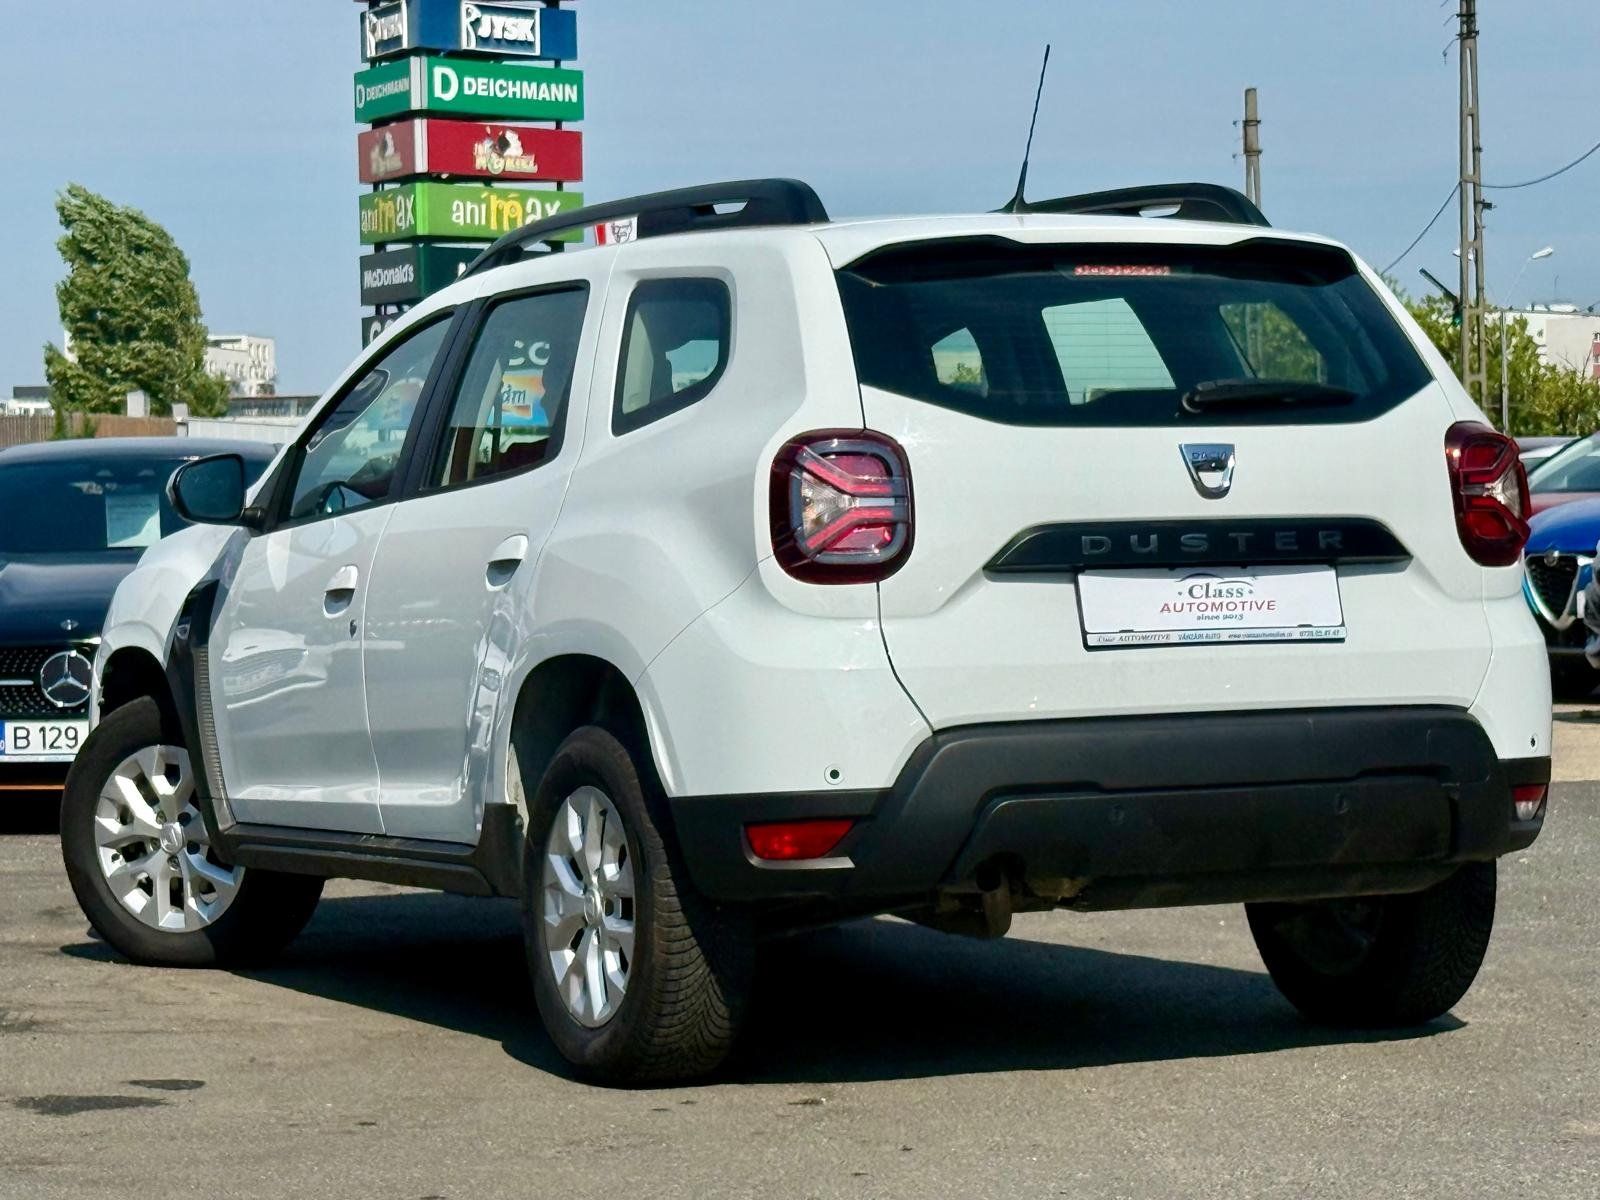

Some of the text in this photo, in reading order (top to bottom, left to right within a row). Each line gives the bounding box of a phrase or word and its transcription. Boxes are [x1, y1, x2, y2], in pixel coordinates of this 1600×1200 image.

[478, 14, 535, 42] JYSK
[366, 76, 410, 101] DEICHMANN
[433, 66, 578, 102] D DEICHMANN
[361, 193, 415, 234] animax
[451, 194, 561, 232] animax
[363, 263, 414, 289] McDonald's
[1081, 531, 1344, 555] DUSTER
[1187, 582, 1245, 599] Class
[1159, 600, 1276, 613] AUTOMOTIVE
[13, 726, 31, 750] B
[38, 726, 79, 750] 129
